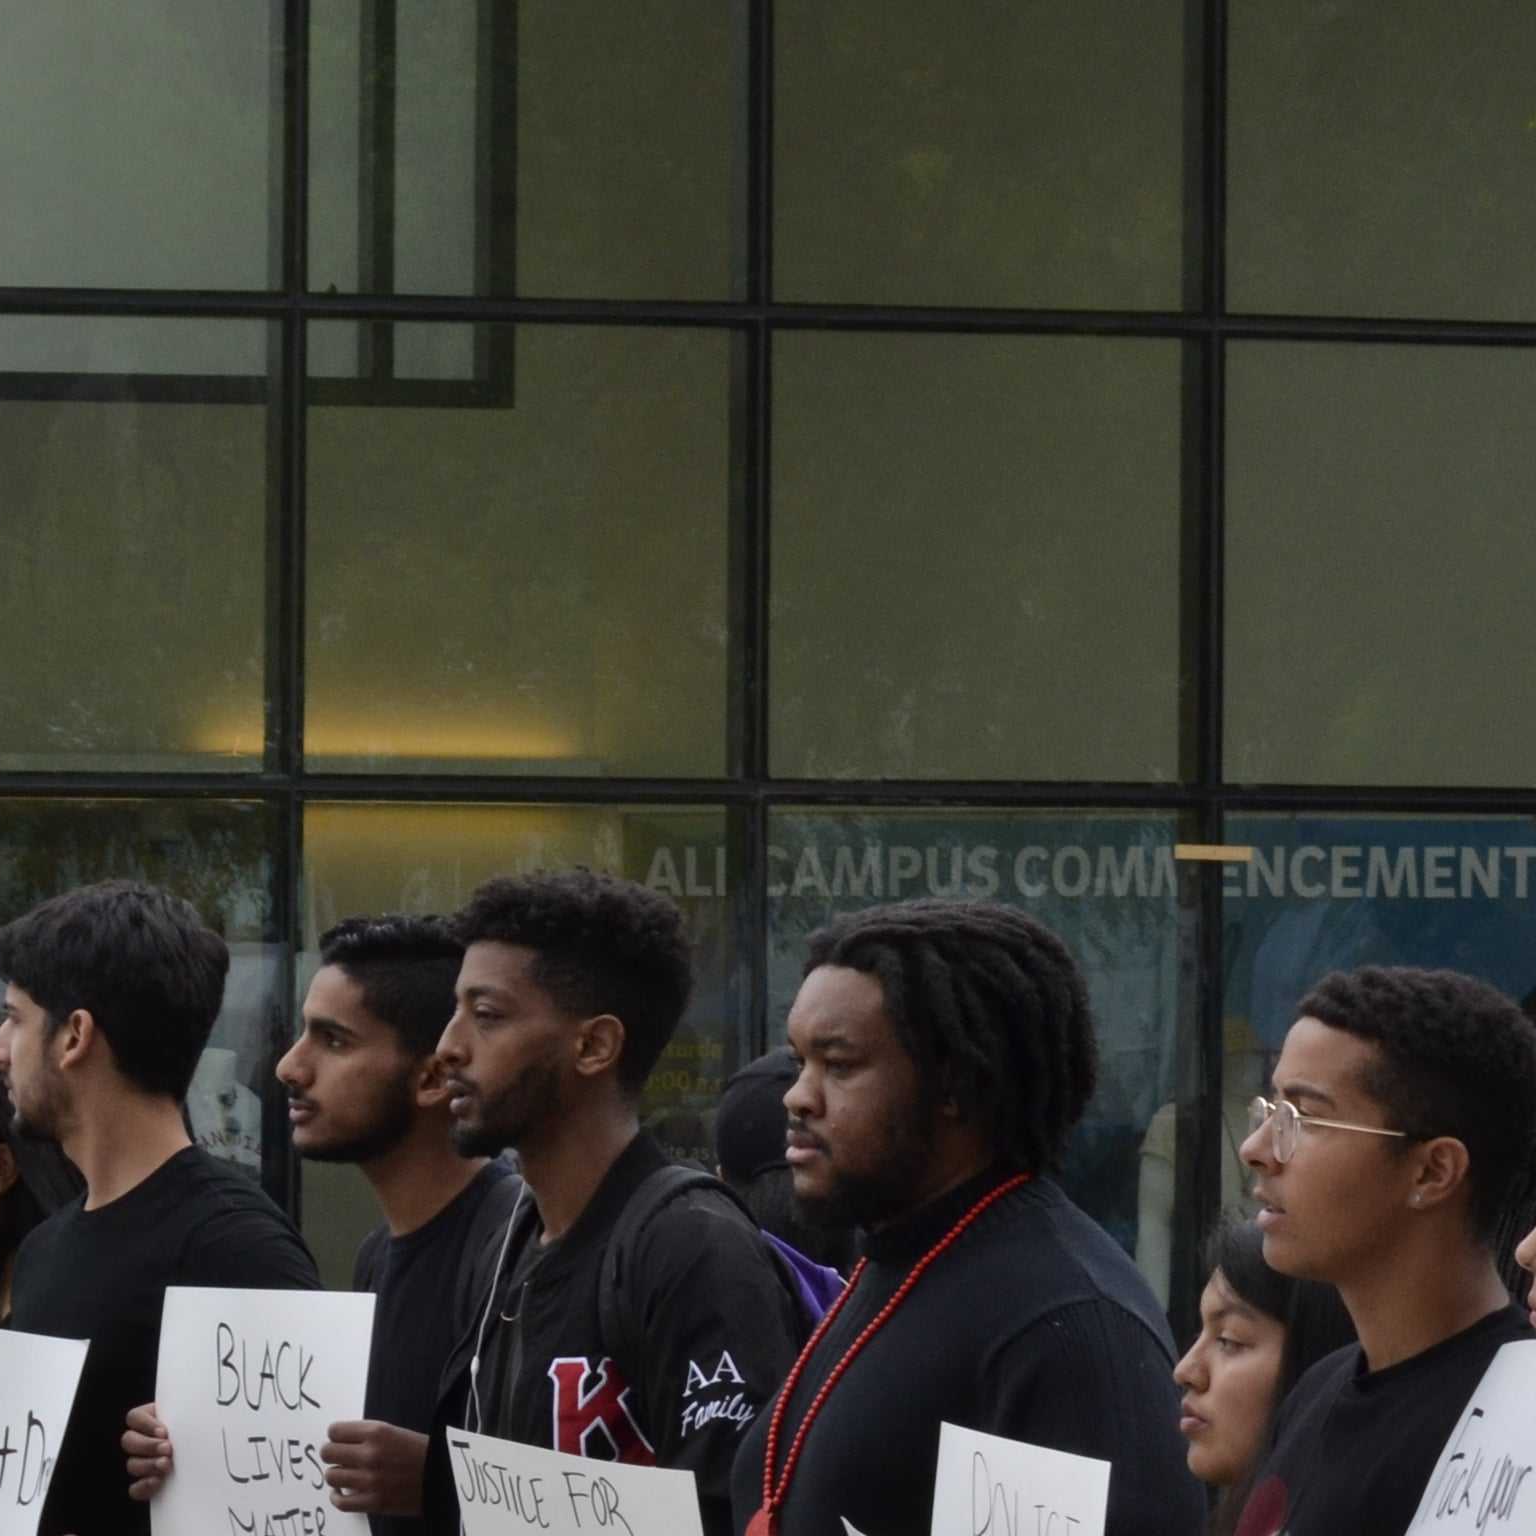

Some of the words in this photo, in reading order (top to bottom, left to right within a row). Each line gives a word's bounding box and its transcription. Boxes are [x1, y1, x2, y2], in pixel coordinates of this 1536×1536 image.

[215, 1321, 321, 1412] BLACK
[548, 1356, 657, 1468] K
[682, 1350, 747, 1398] AA
[680, 1391, 756, 1438] Family
[224, 1435, 325, 1487] LIVES
[460, 1439, 547, 1529] JUSTICE
